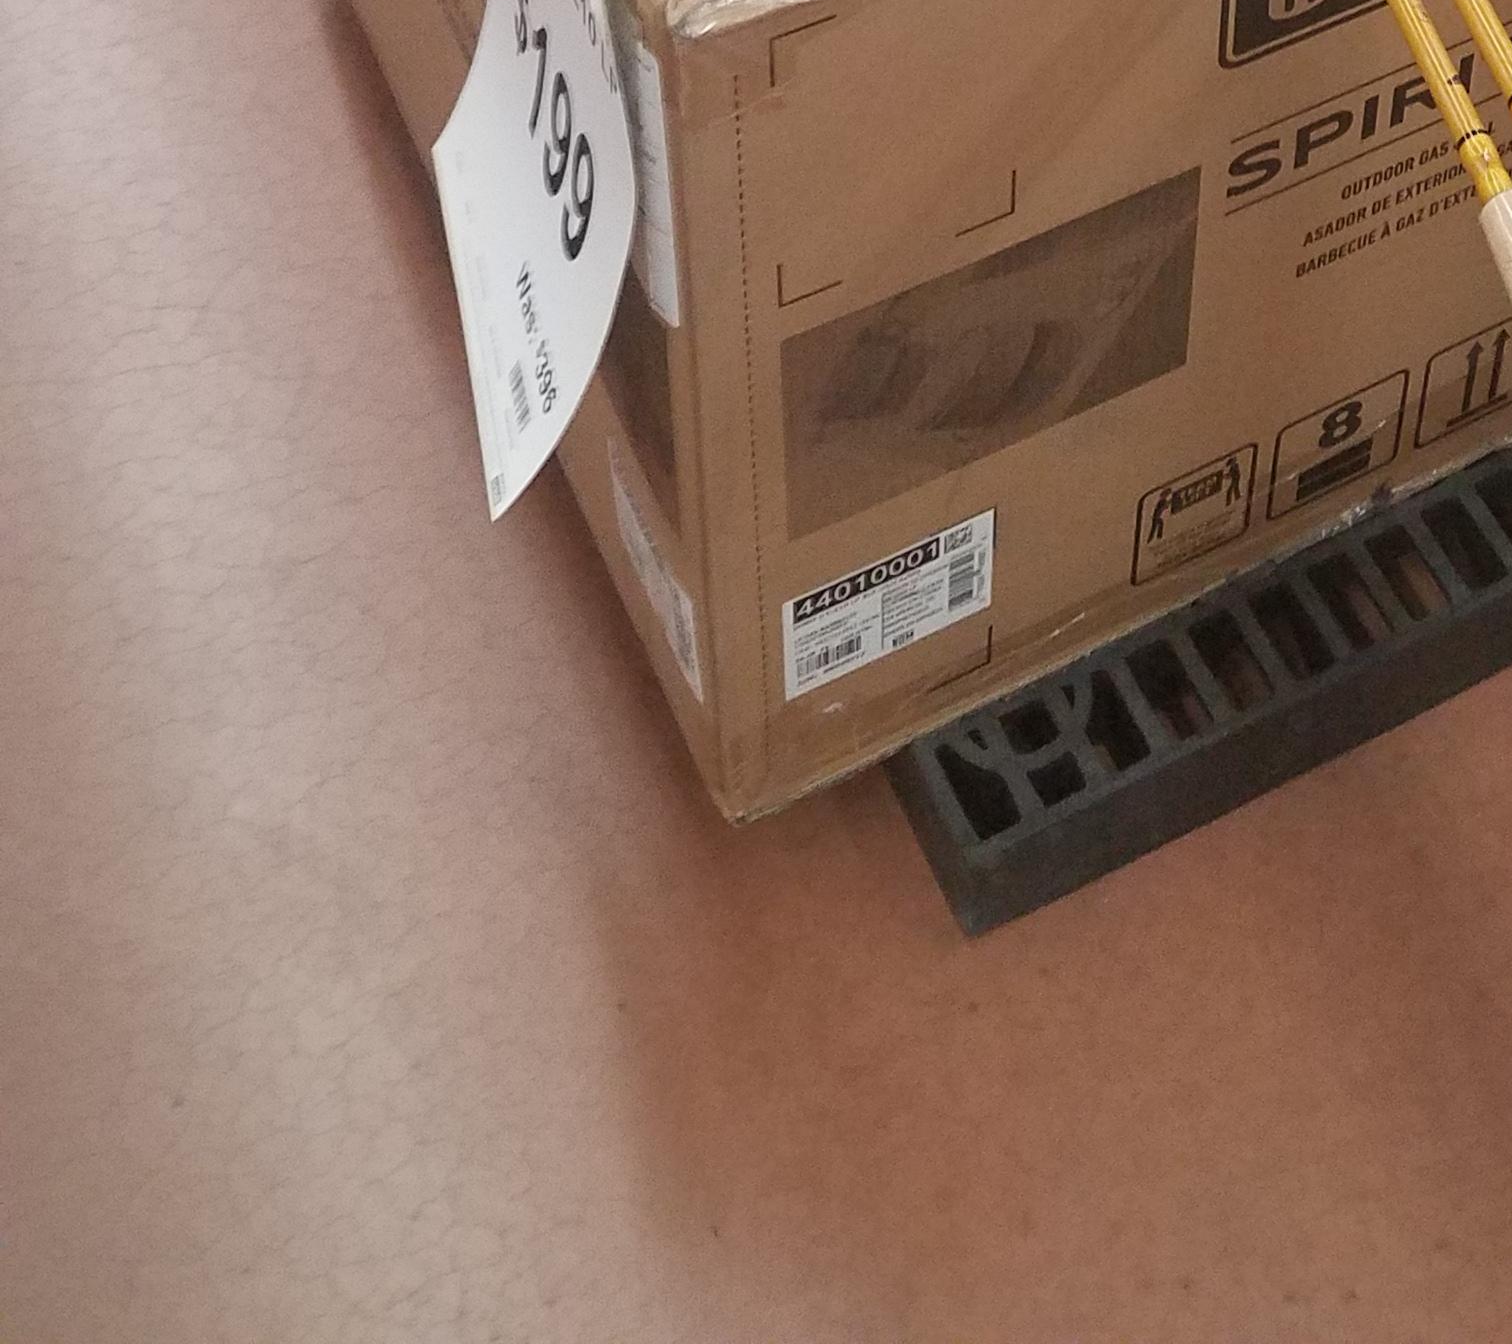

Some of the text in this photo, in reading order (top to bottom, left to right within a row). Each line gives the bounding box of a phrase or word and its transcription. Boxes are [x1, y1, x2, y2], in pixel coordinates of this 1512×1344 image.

[1341, 141, 1450, 200] OUTDOOR GAS
[1295, 208, 1426, 279] BARBECUE À GAZ
[1303, 210, 1368, 248] ASADOR
[1371, 197, 1392, 219] DE
[1320, 400, 1363, 448] 8
[796, 539, 939, 618] 44010001
